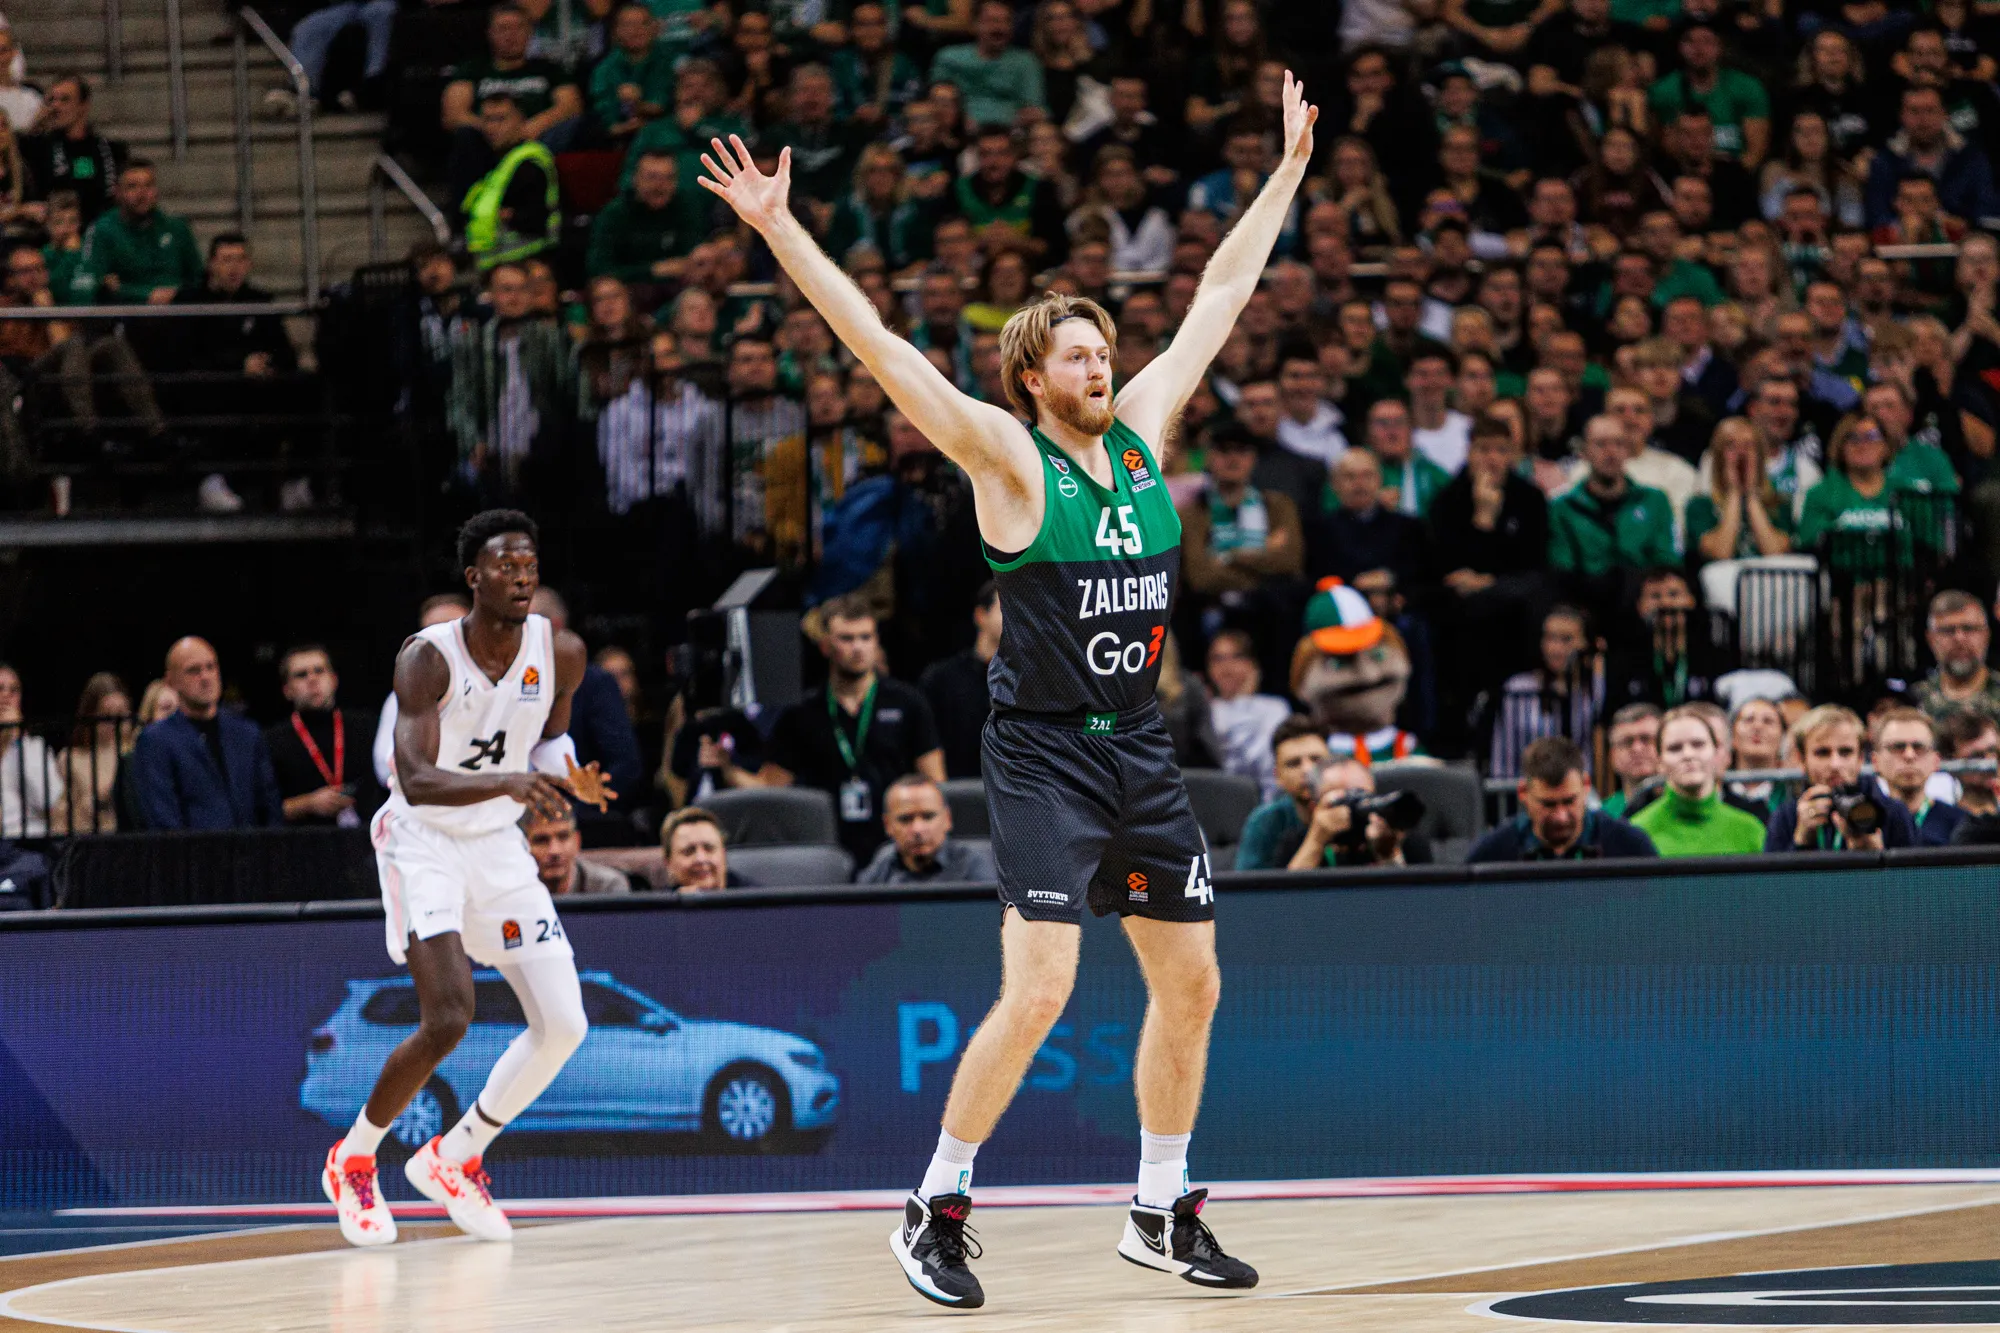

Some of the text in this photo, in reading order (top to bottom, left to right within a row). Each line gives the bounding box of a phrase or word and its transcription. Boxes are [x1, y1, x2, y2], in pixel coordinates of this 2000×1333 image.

[1095, 505, 1143, 556] 45
[458, 730, 507, 771] 24
[535, 918, 562, 943] 24
[898, 1001, 1132, 1095] Pss
